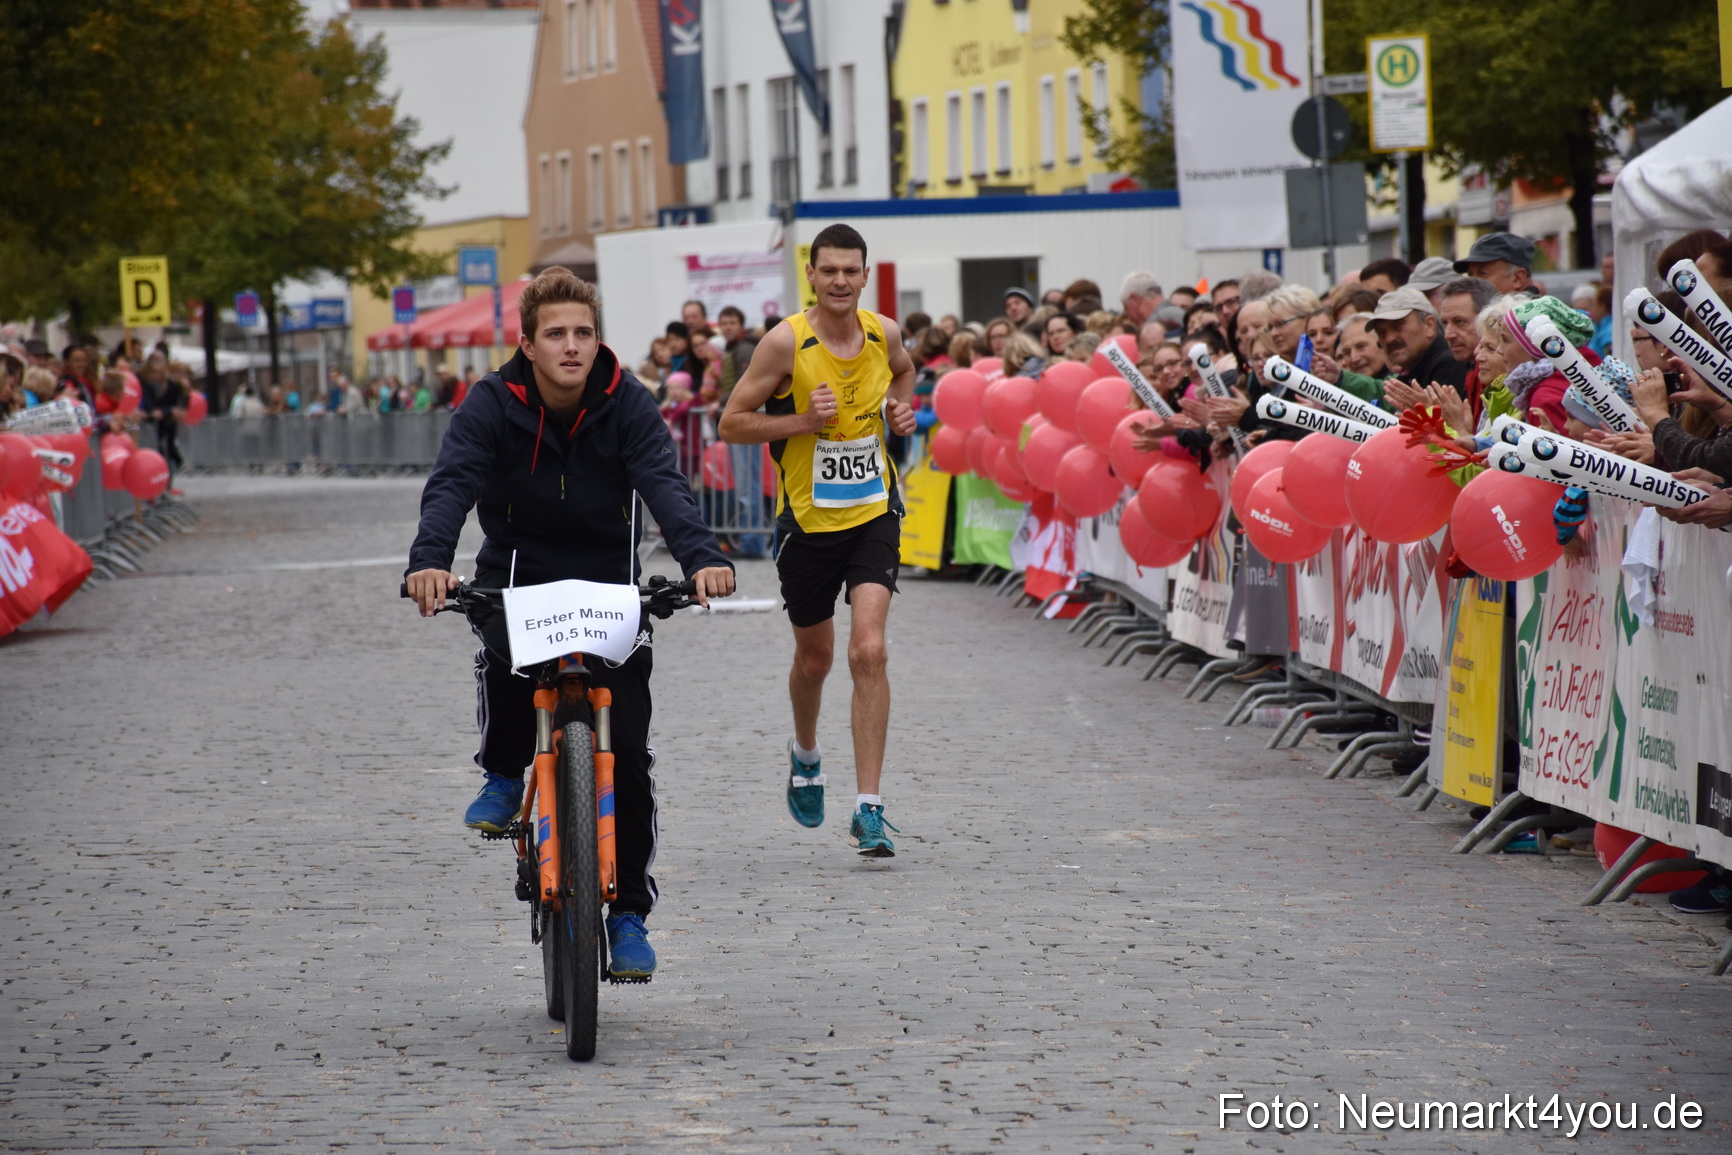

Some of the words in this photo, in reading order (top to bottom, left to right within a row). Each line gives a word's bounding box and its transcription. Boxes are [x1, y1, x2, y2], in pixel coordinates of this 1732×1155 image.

[134, 280, 156, 310] D
[1669, 324, 1732, 390] bmw-la
[1295, 409, 1341, 435] BMW
[816, 445, 841, 454] PARTL
[842, 442, 875, 453] Neumarkt
[821, 452, 879, 480] 3054
[1569, 448, 1626, 482] BMW
[1250, 508, 1294, 533] RÖDL
[1491, 504, 1527, 561] RÖDL
[1503, 538, 1521, 563] energie
[525, 611, 575, 631] Erster
[580, 608, 624, 621] Mann
[546, 627, 579, 645] 10,5
[584, 627, 608, 641] km
